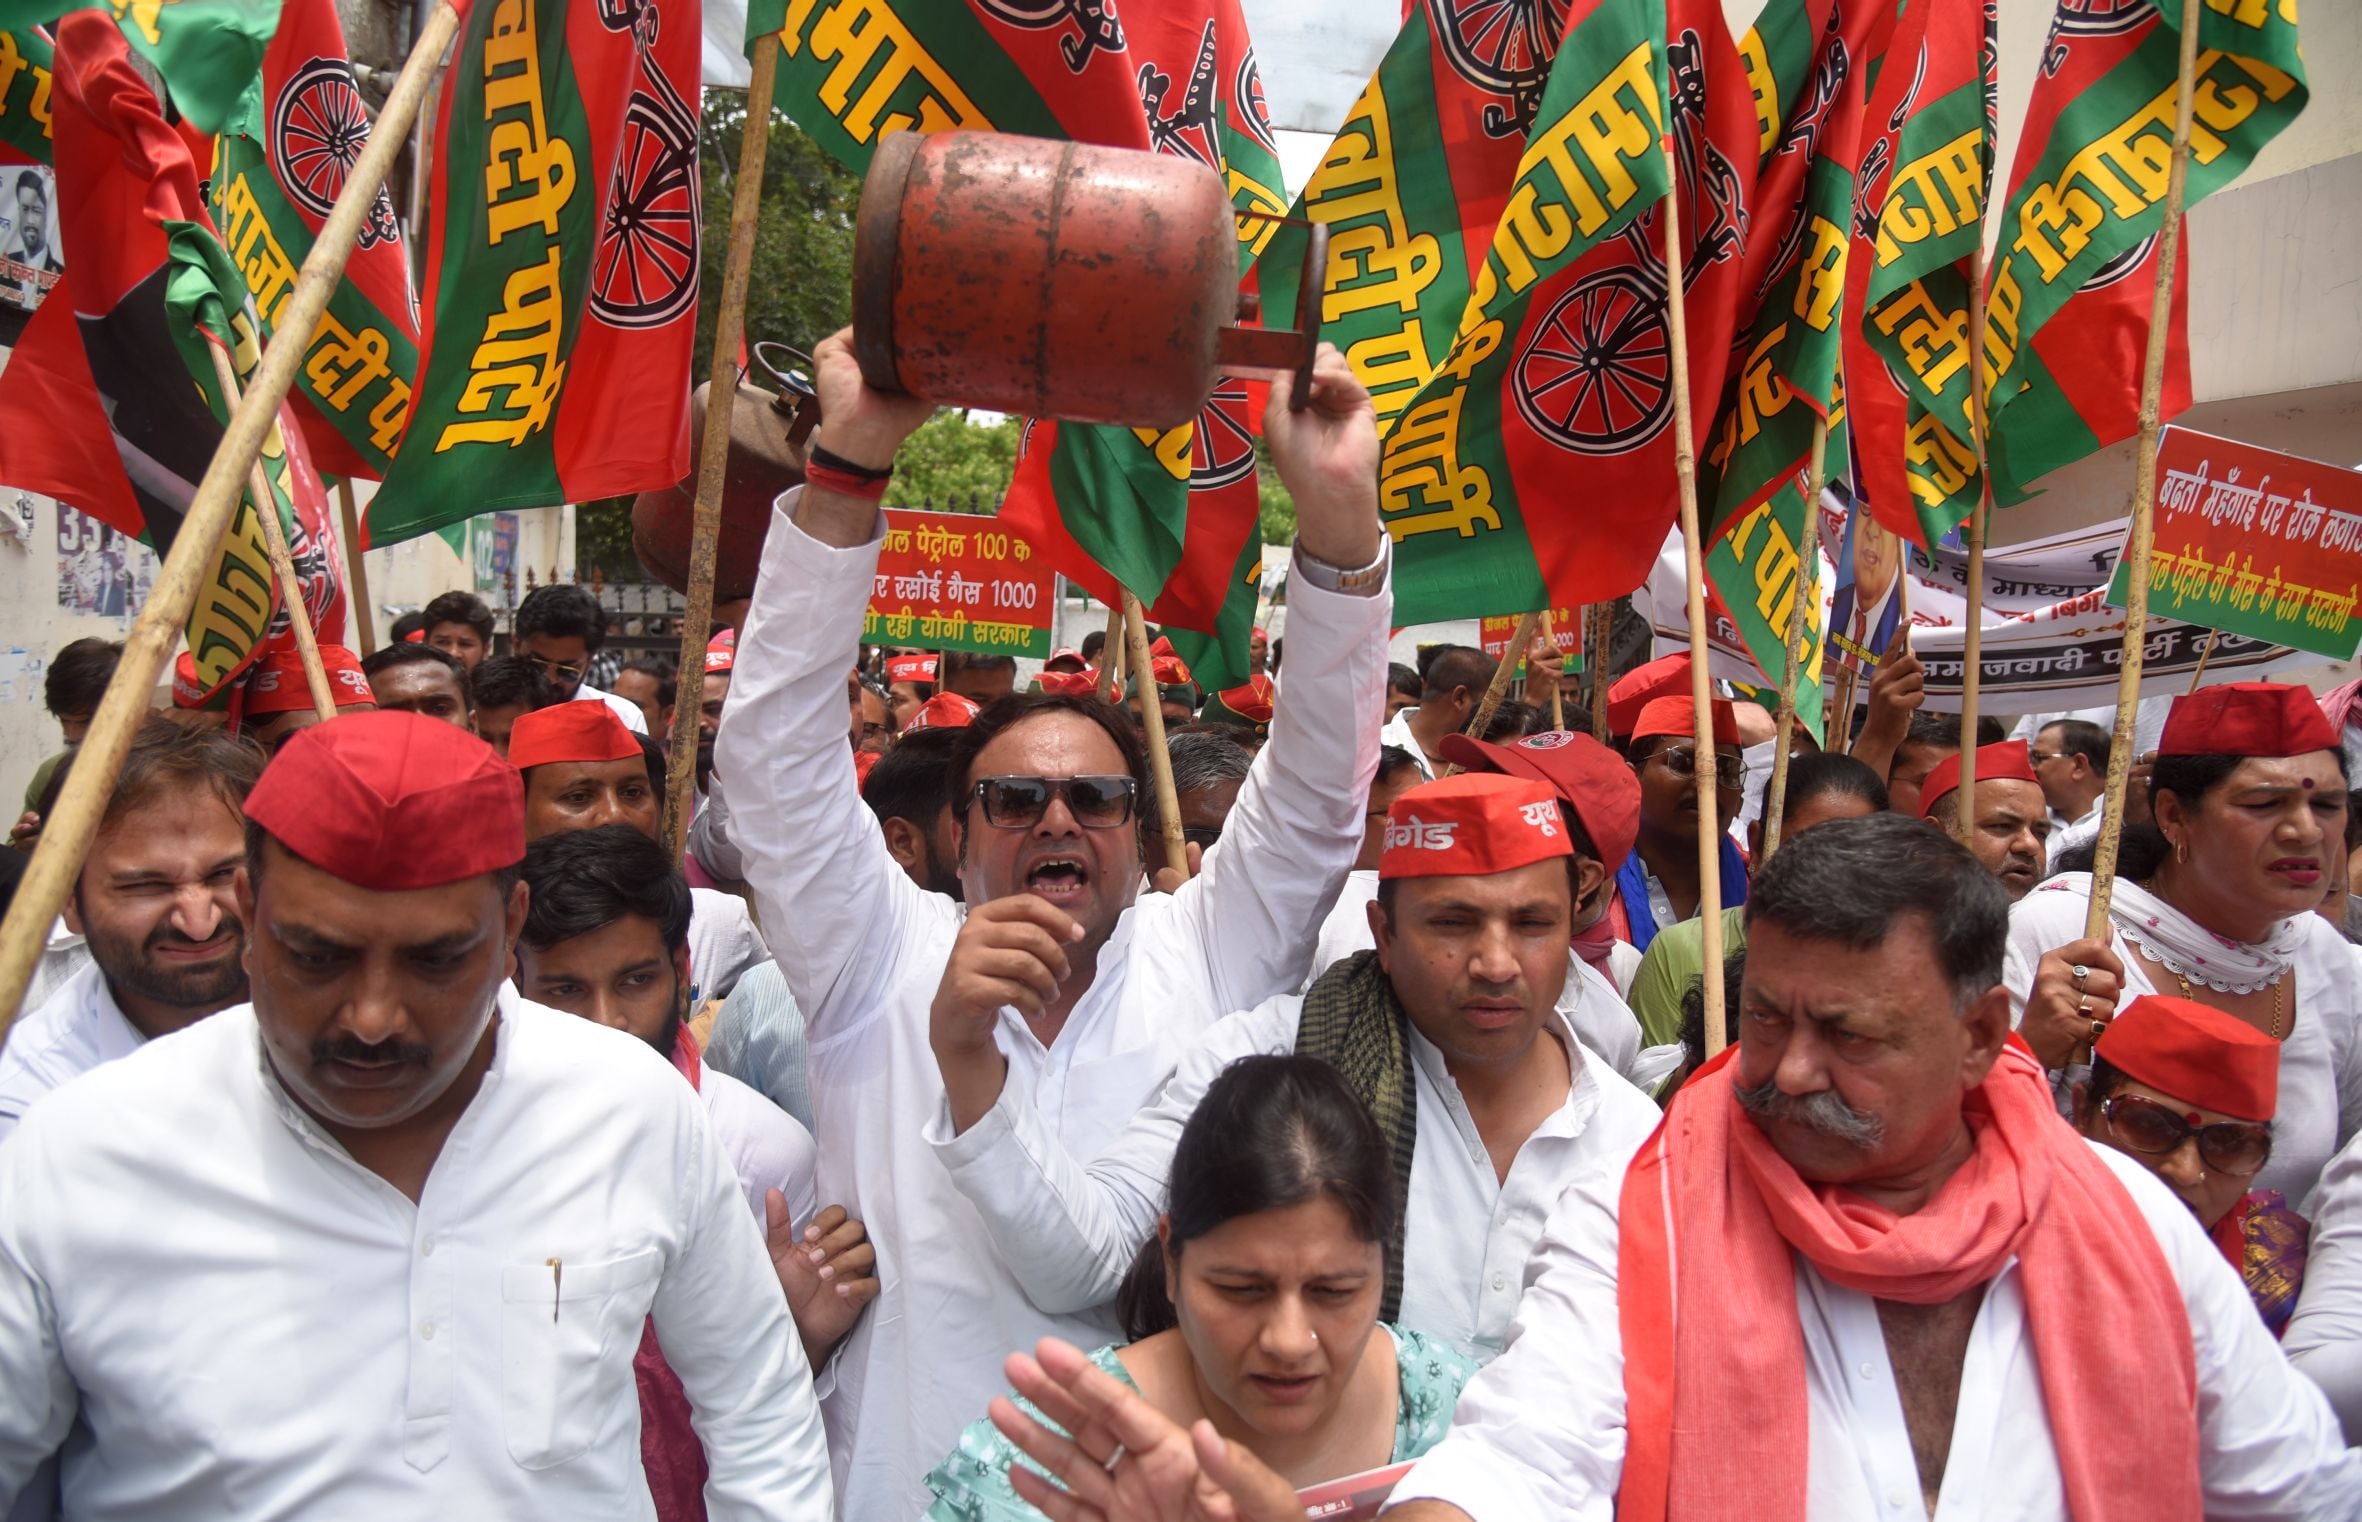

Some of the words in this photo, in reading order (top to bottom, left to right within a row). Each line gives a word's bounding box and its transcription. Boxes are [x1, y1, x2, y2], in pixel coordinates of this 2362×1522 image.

[433, 245, 565, 454] पार्टी
[2159, 459, 2209, 524] बढ़ती
[2260, 493, 2291, 536] पर
[2285, 488, 2326, 543] रोक
[916, 523, 966, 562] पेट्रोल
[973, 532, 1007, 560] 100
[894, 569, 943, 603] रसोई
[947, 571, 984, 605] गैस
[990, 579, 1037, 610] 1000
[2230, 554, 2264, 611] गैस
[2259, 565, 2287, 615] के
[2275, 582, 2311, 622] दाम
[2305, 583, 2358, 634] घटाओ
[885, 605, 916, 639] रही
[920, 609, 969, 641] योगी
[972, 620, 1034, 648] सरकार
[1922, 648, 2092, 678] समजवादी
[1519, 799, 1560, 837] यूथ
